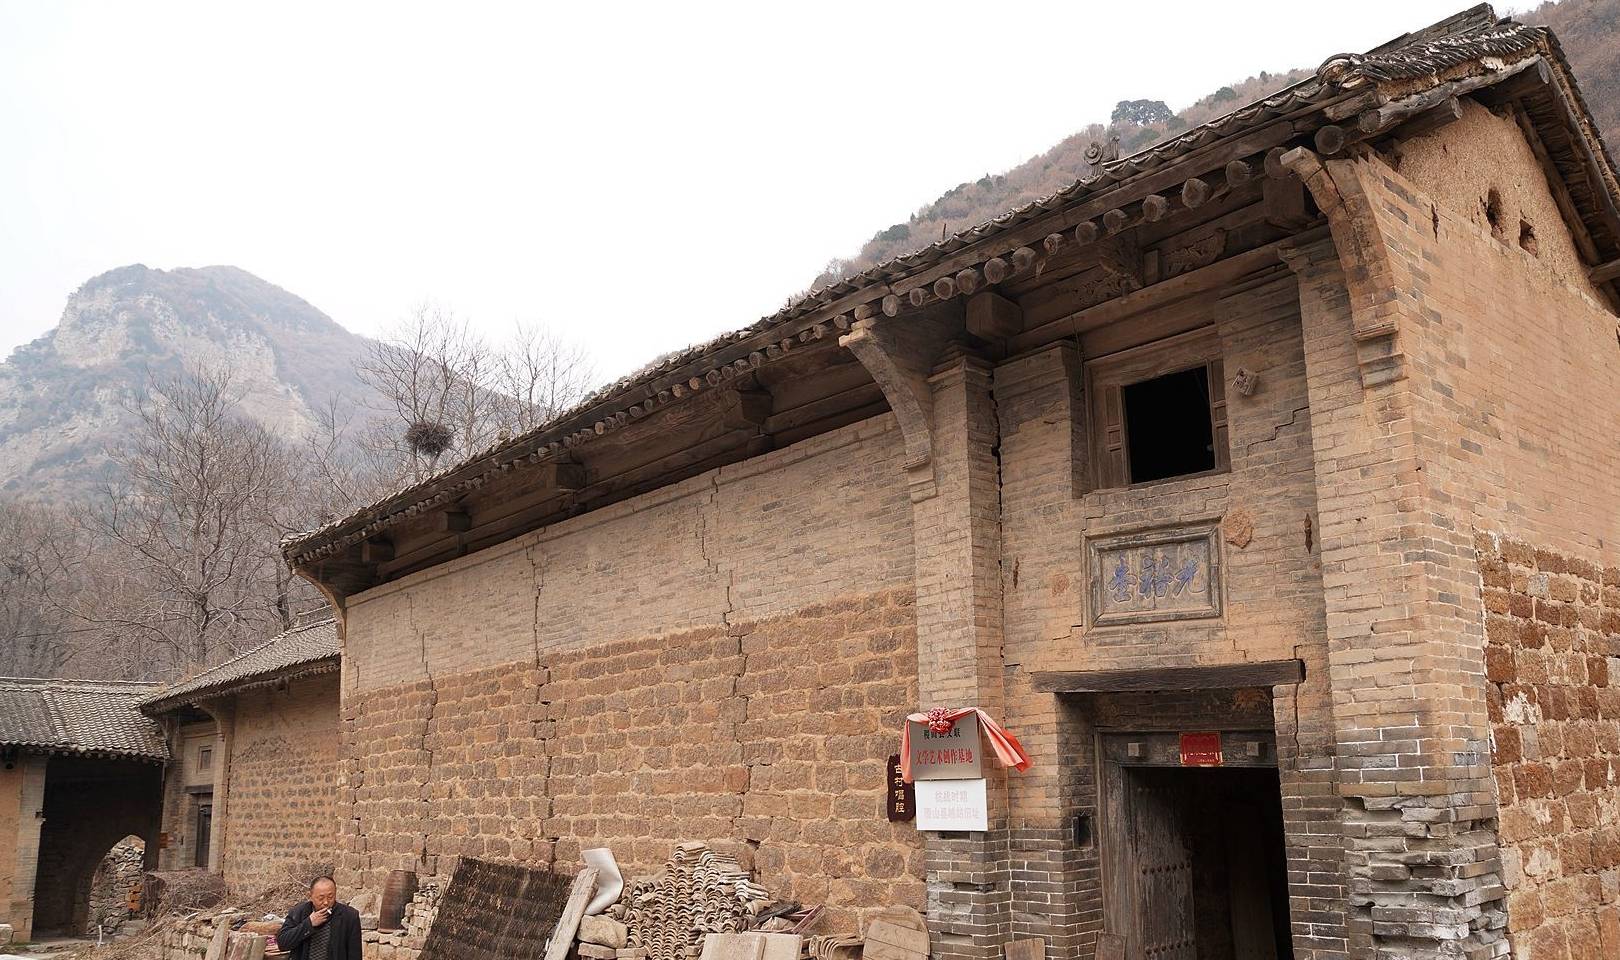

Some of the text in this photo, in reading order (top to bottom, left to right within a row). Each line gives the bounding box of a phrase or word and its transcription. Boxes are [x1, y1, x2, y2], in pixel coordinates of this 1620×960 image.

[916, 749, 973, 767] 文学艺术创作基地
